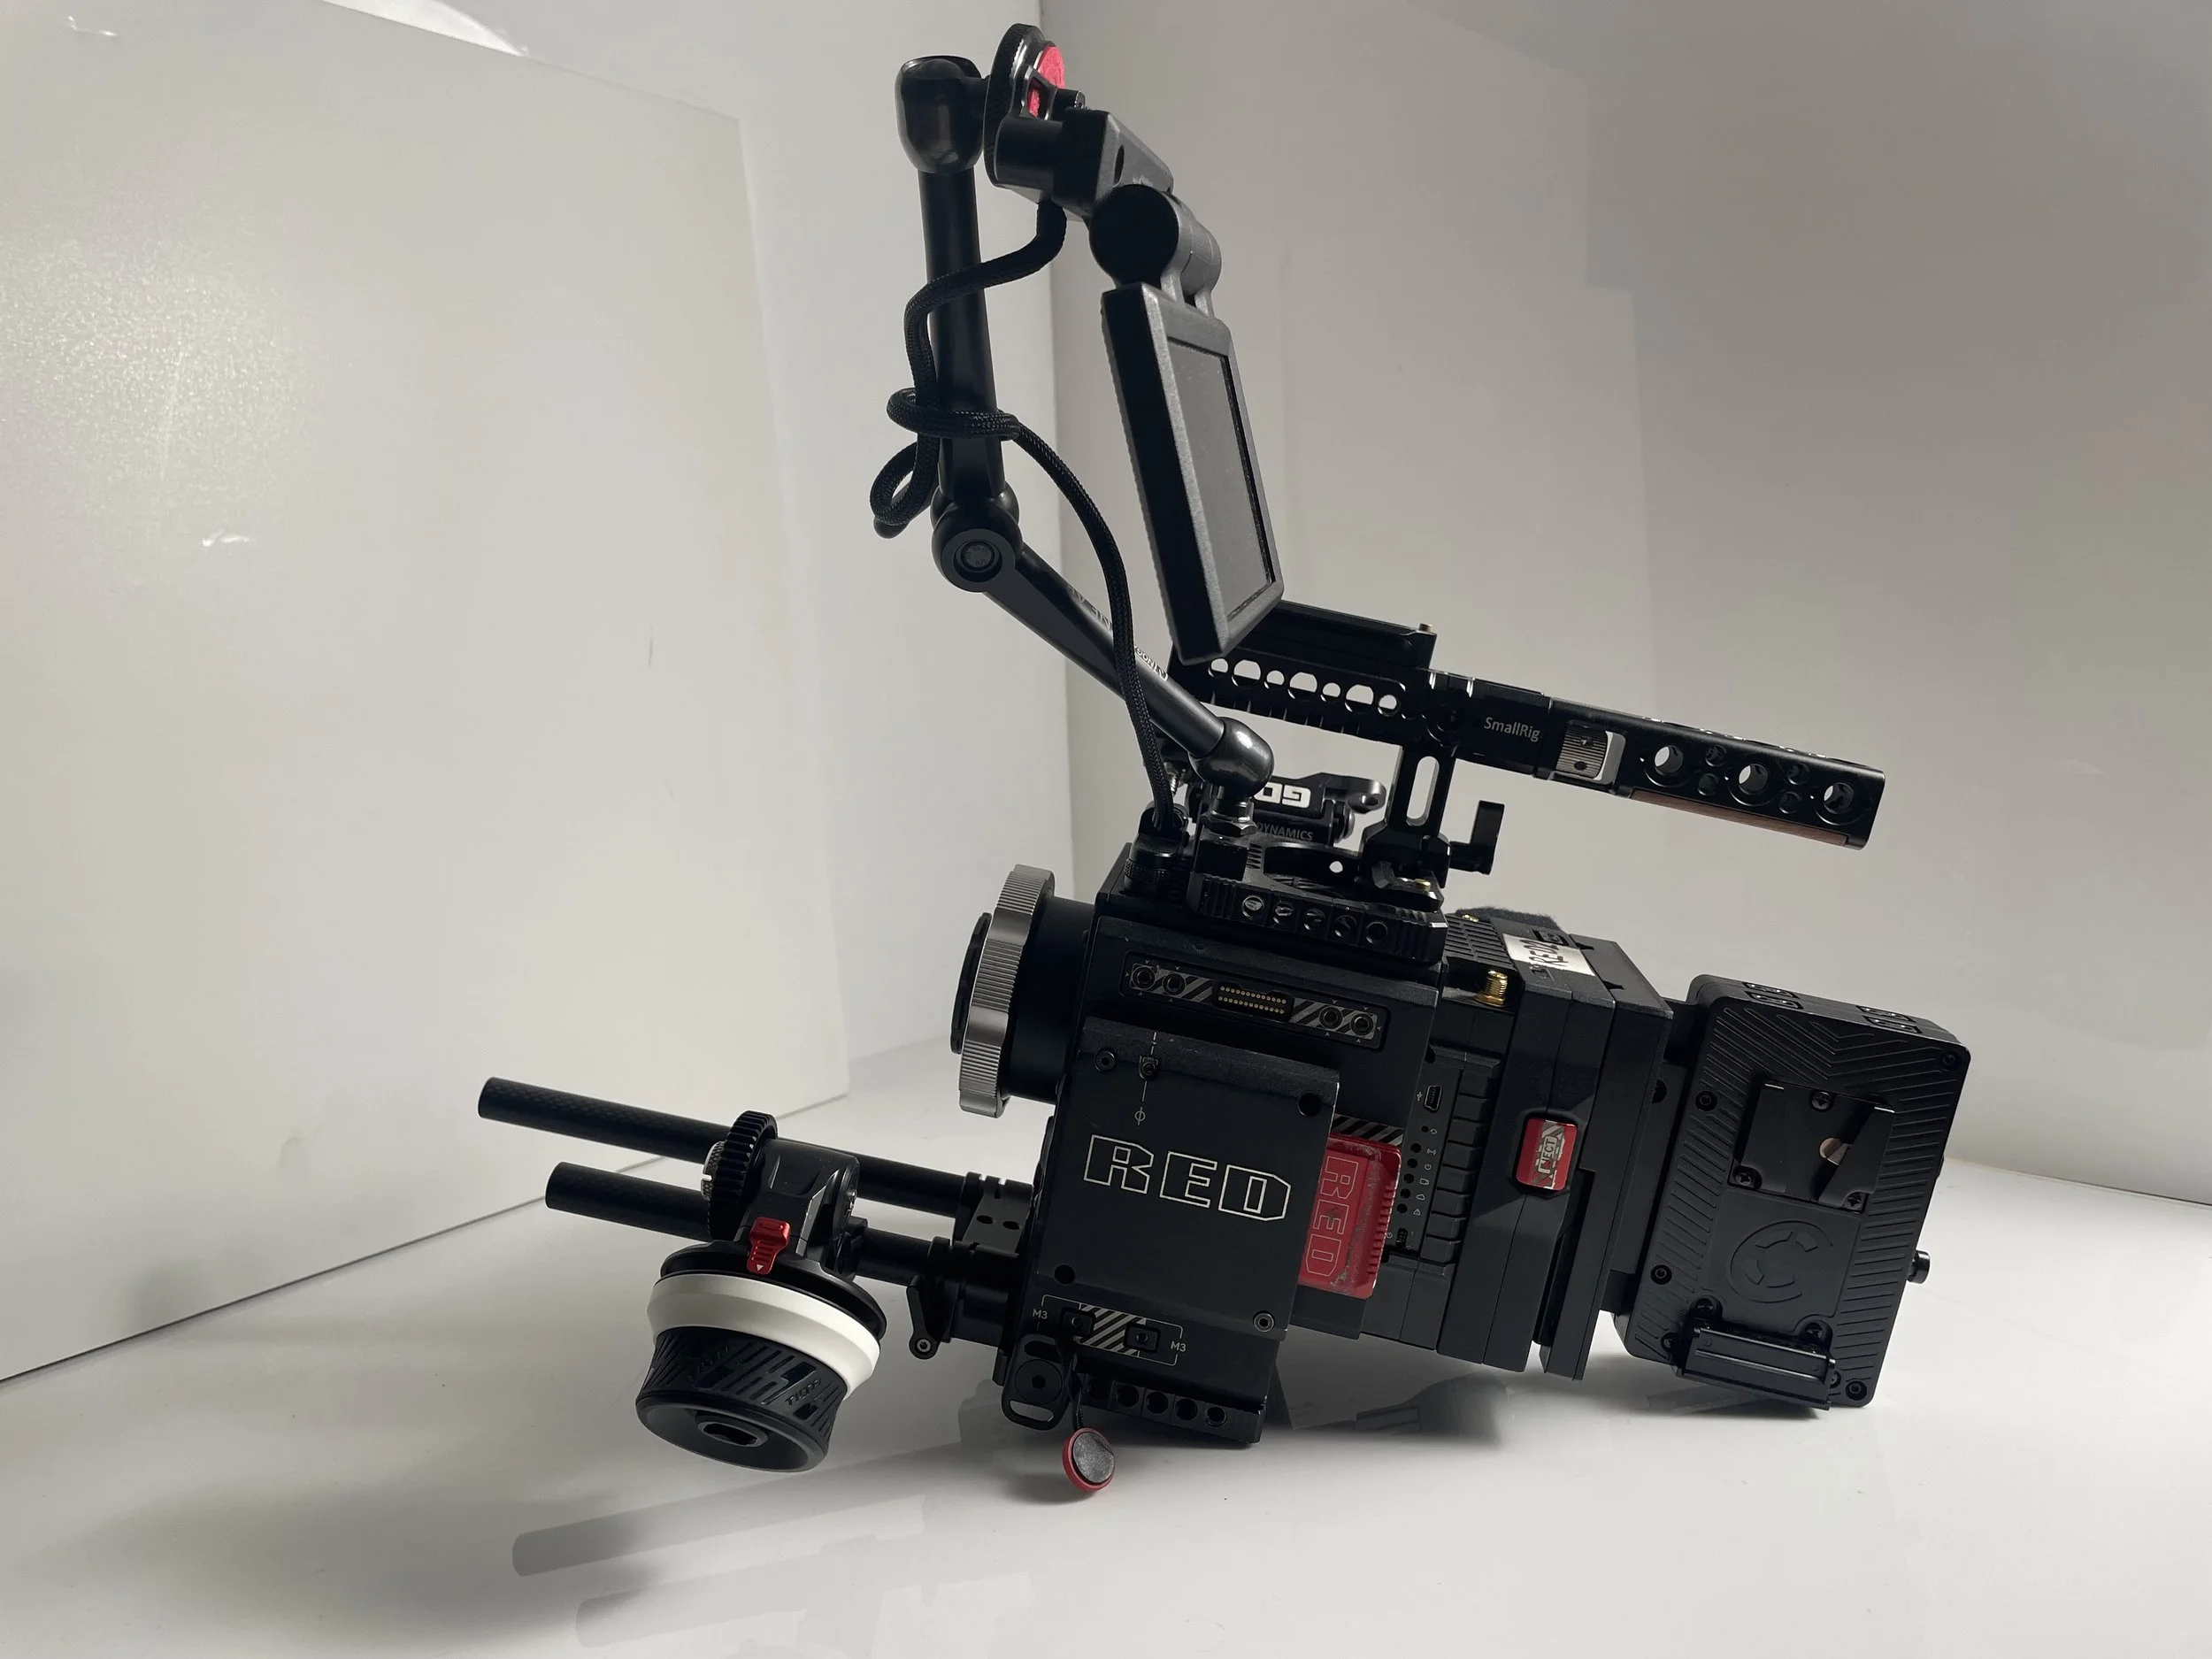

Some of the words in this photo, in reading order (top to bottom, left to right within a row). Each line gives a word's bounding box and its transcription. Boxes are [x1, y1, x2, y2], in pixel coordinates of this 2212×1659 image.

[1484, 717, 1541, 742] SmallRig
[1083, 1133, 1292, 1222] RED
[1303, 1154, 1359, 1279] RED
[1032, 1308, 1048, 1321] M3
[1170, 1340, 1187, 1353] M3
